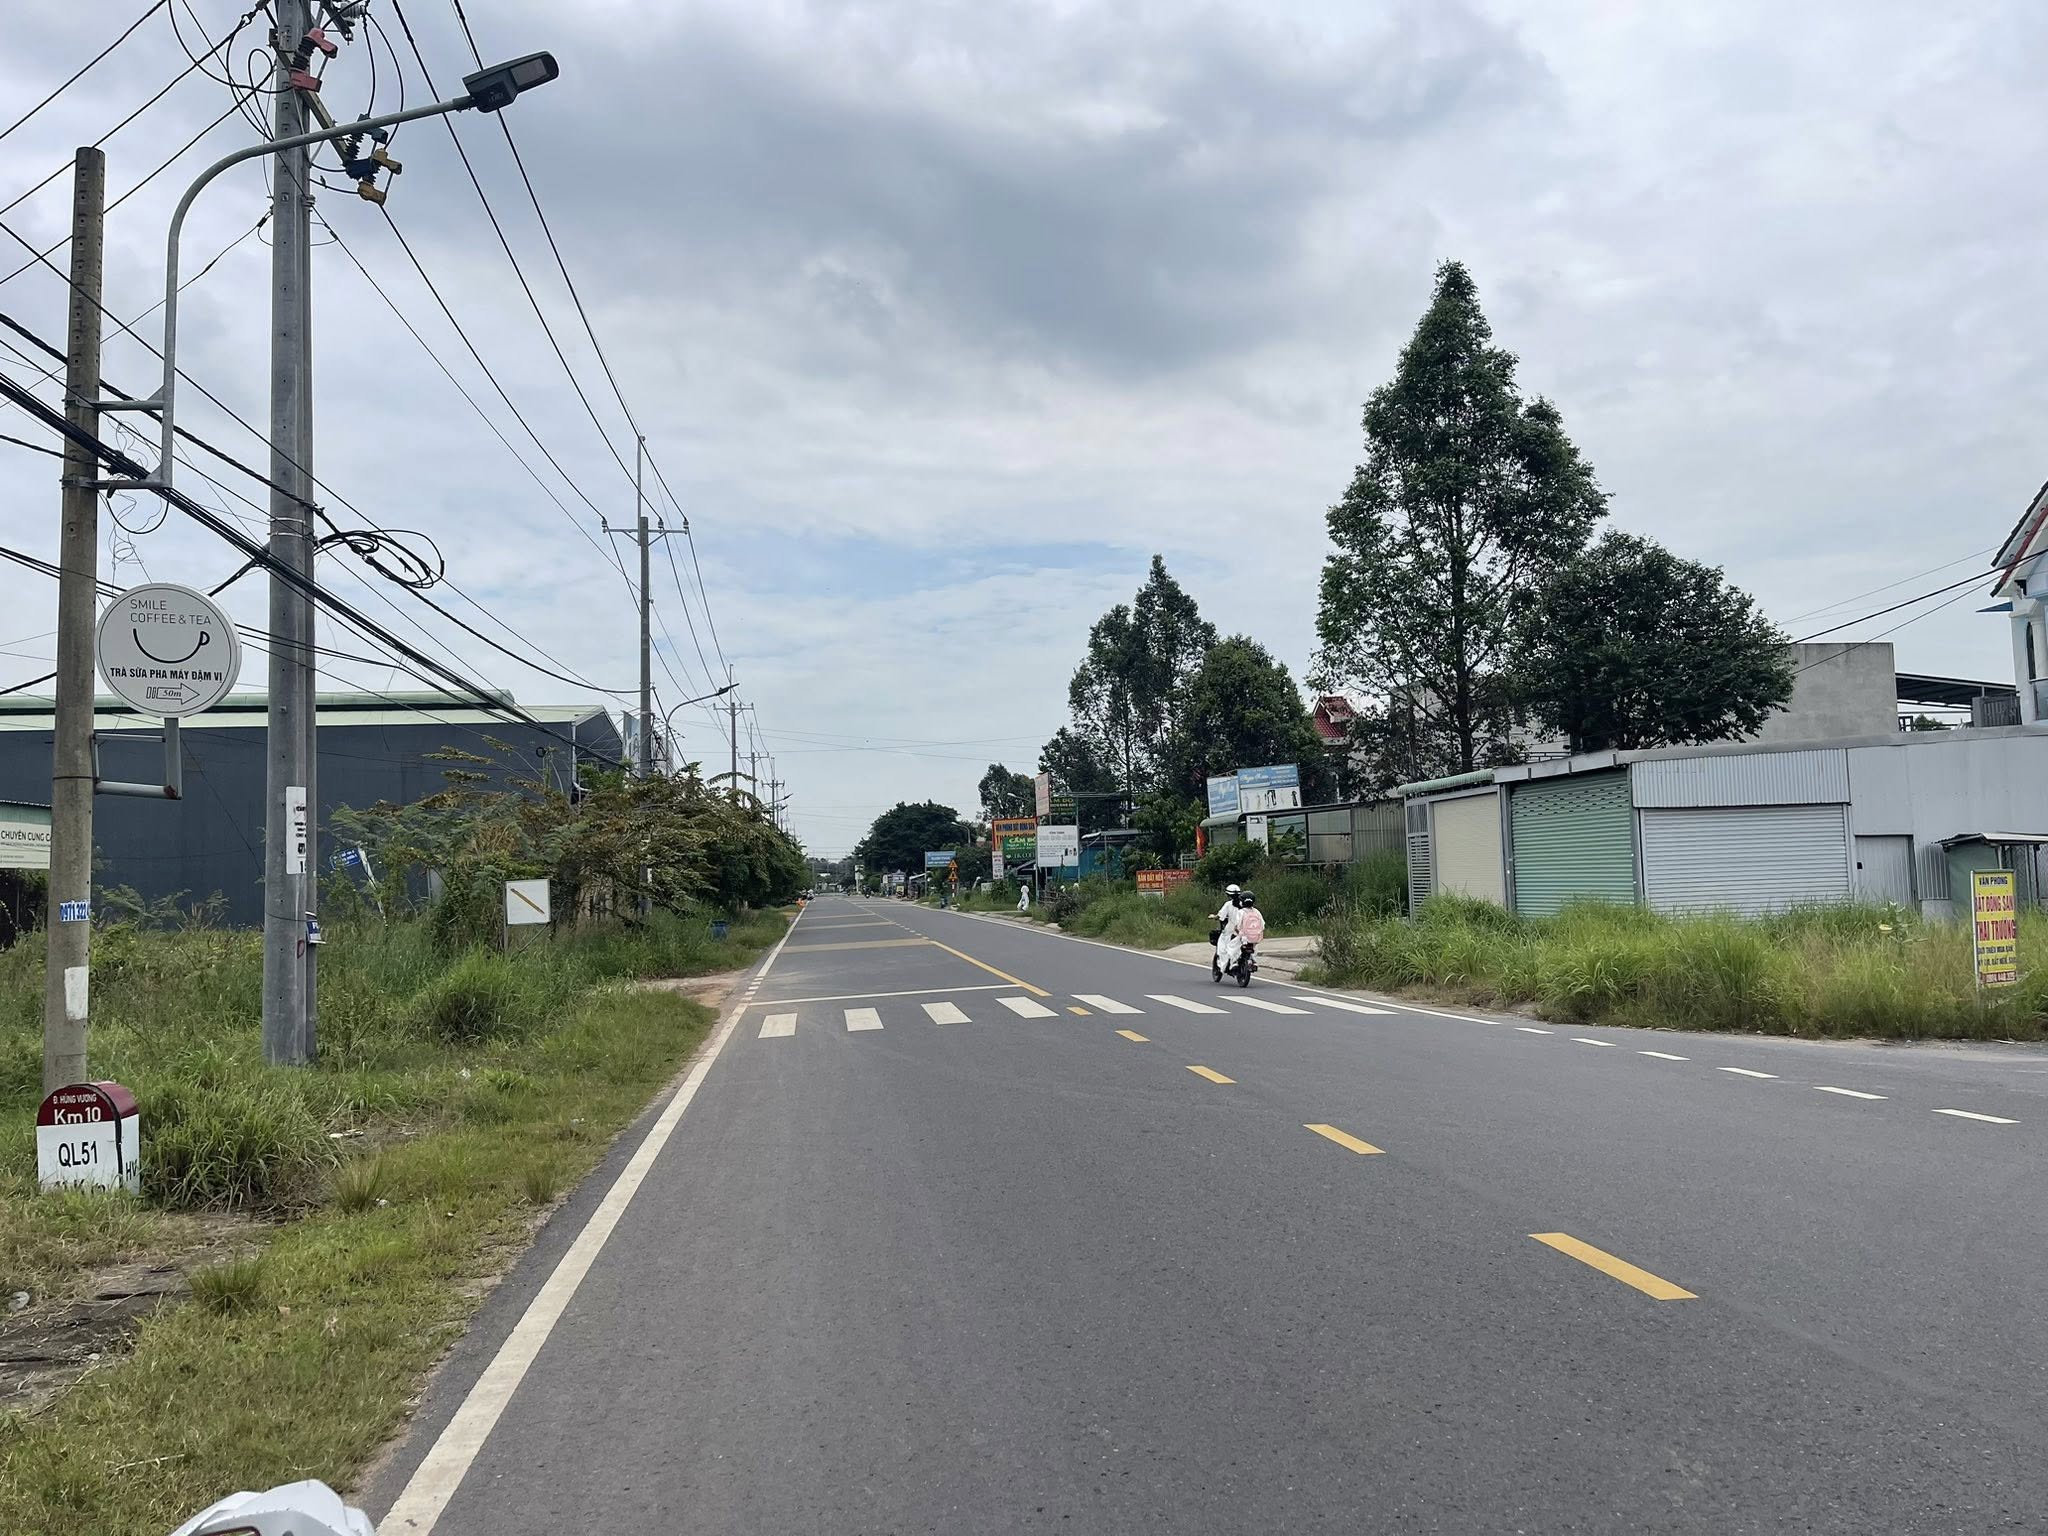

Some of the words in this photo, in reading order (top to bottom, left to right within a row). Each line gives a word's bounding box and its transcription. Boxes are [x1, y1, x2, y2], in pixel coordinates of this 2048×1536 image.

[130, 599, 167, 610] SMILE
[130, 612, 177, 624] COFFEE
[178, 615, 187, 625] &
[189, 614, 212, 625] TEA
[110, 666, 127, 678] TRÀ
[129, 666, 147, 678] SỮA
[149, 669, 167, 679] PHA
[169, 669, 189, 680] MÁY
[191, 670, 211, 682] ĐẬM
[213, 671, 223, 683] VỊ
[162, 690, 182, 698] 50m
[0, 829, 27, 840] CHUYÊN
[27, 832, 45, 842] CUNG
[58, 1140, 98, 1168] QL51
